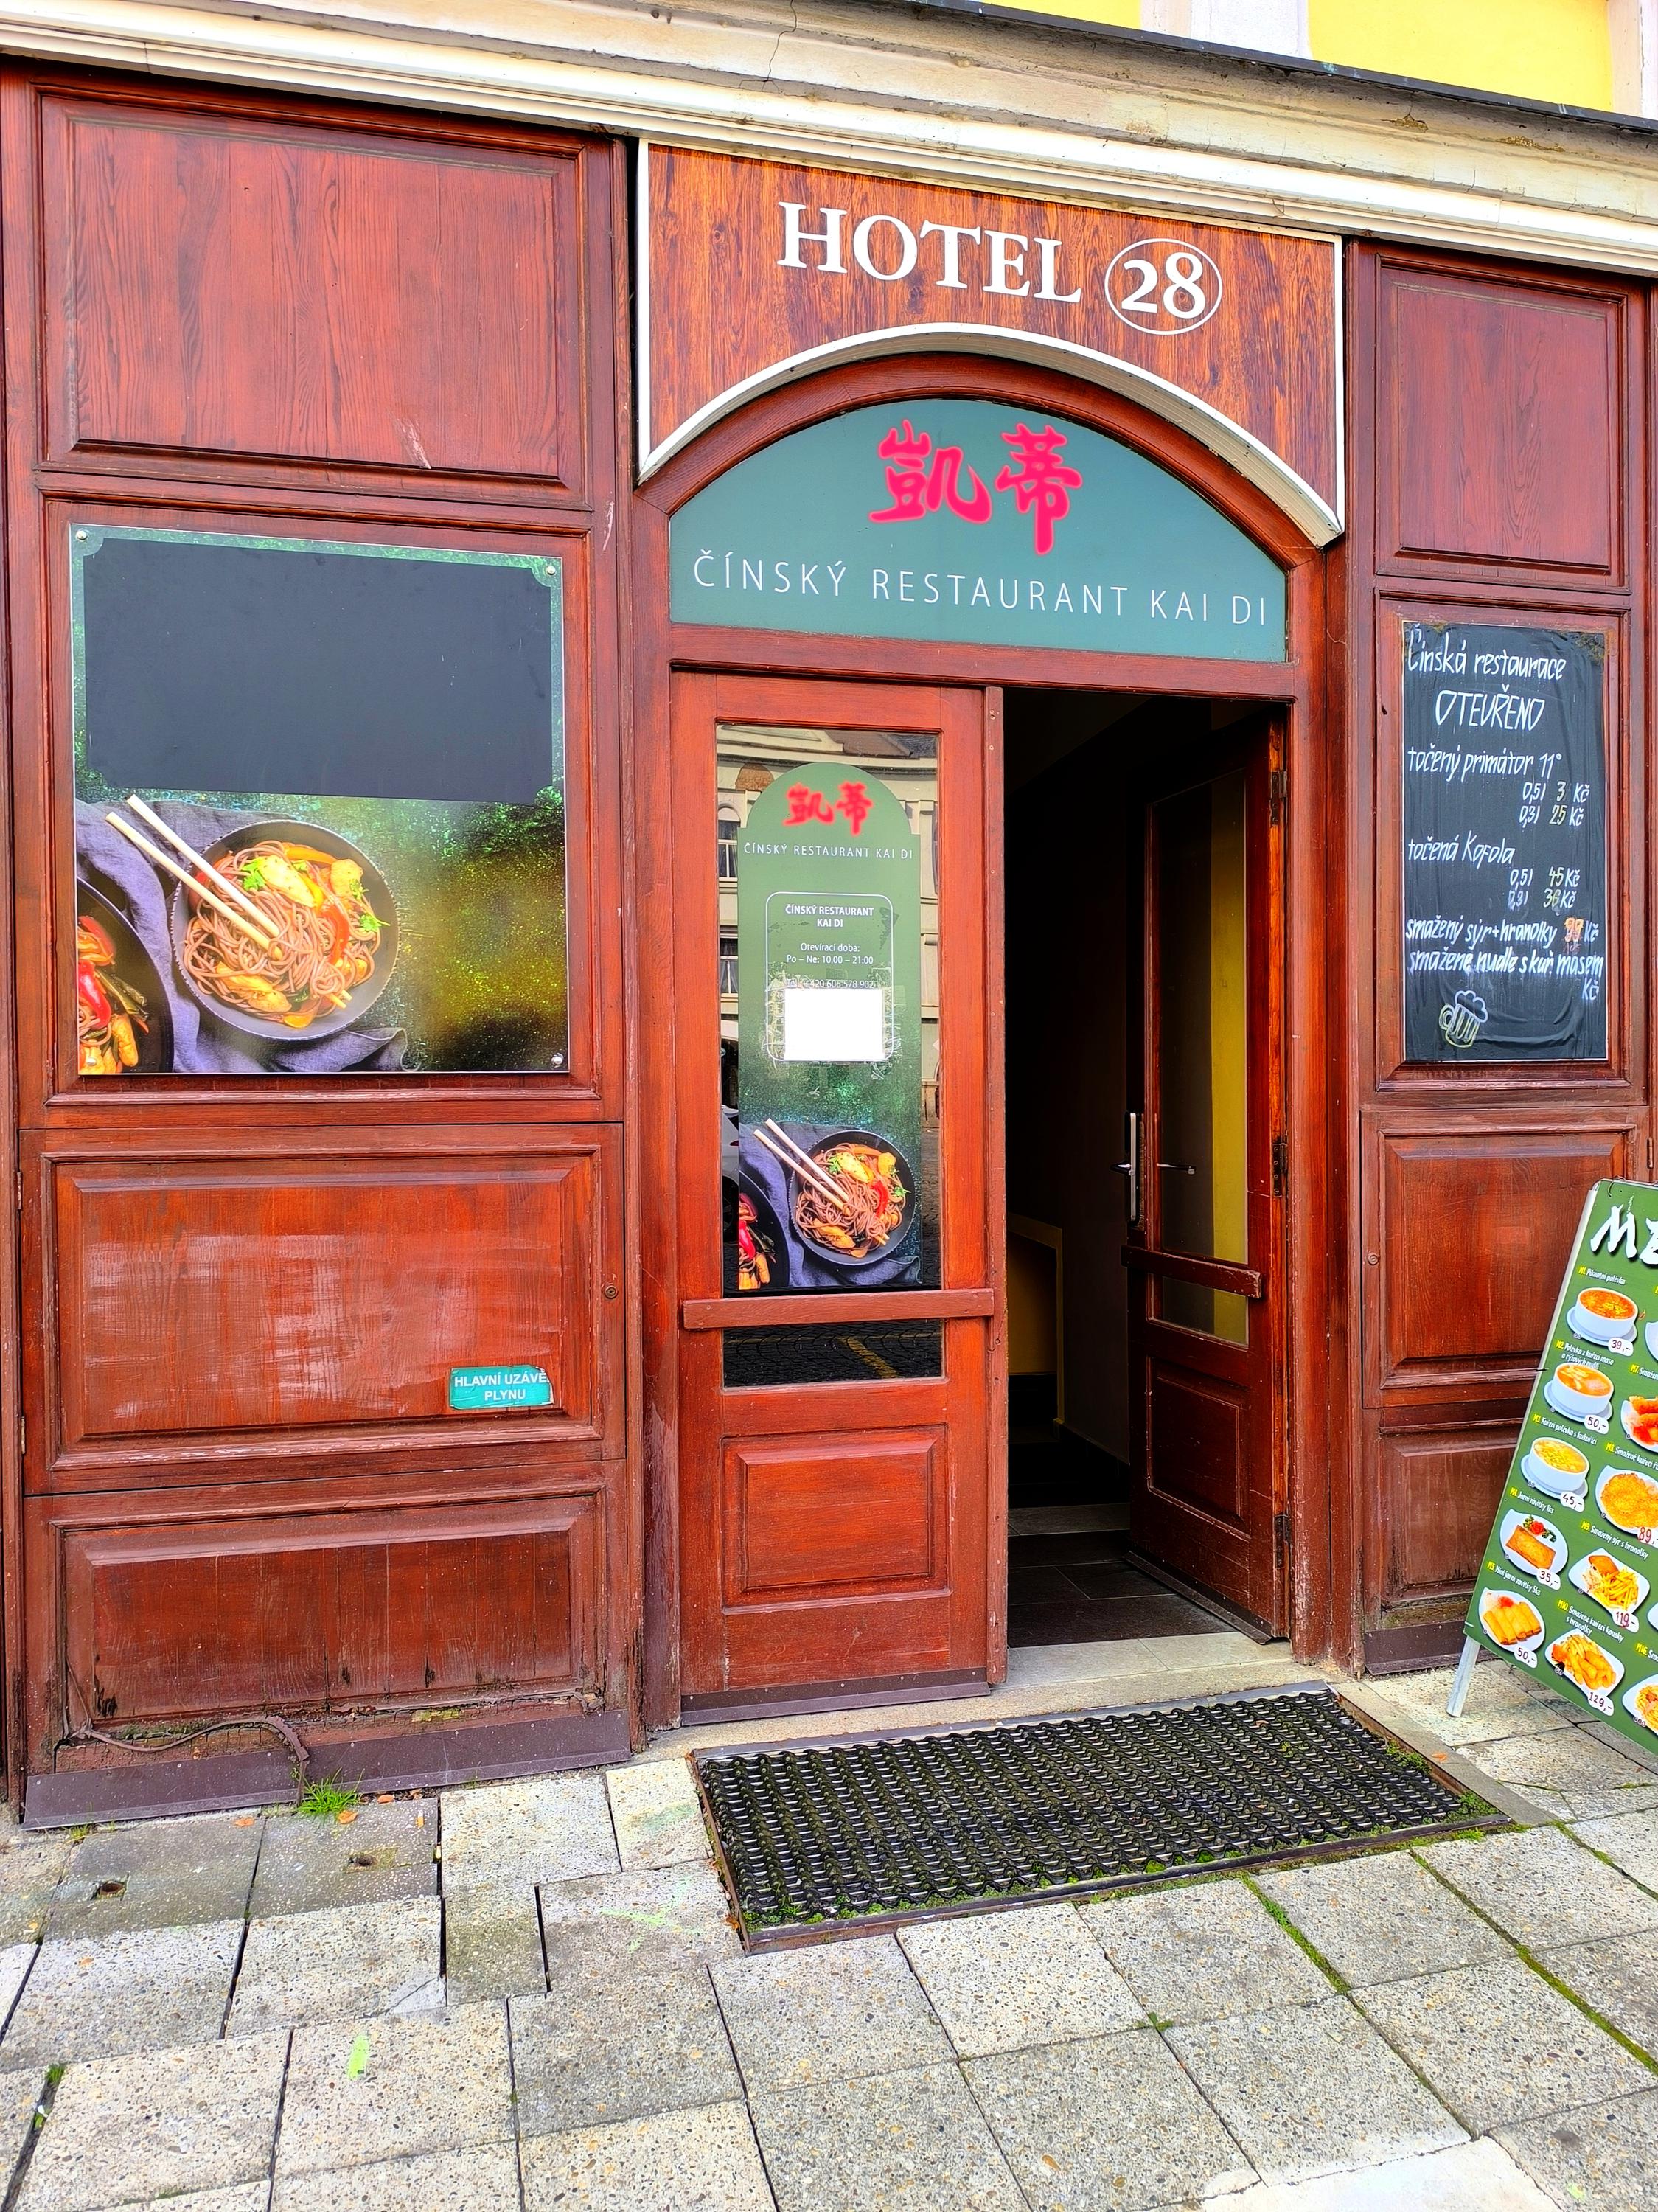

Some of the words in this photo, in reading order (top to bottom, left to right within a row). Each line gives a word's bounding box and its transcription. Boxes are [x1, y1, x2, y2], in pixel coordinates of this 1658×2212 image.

[777, 201, 1082, 303] HOTEL
[1121, 252, 1206, 319] 28
[868, 418, 1084, 557] 凱蒂
[694, 549, 847, 595] ČÍNSKÝ
[873, 568, 1128, 616] RESTAURANT
[1151, 590, 1208, 622] KAI
[1233, 595, 1266, 626] DI
[1474, 649, 1567, 680] restaurace
[1435, 683, 1545, 731] OTEVŘENO
[1407, 742, 1461, 782] točený
[1463, 747, 1534, 782] primátor
[1572, 782, 1590, 803] Kč
[781, 780, 874, 836] 凱蒂
[1549, 804, 1567, 825] 25
[1569, 806, 1584, 826] Kč
[744, 842, 788, 854] ČÍNSKÝ
[794, 845, 870, 858] RESTAURANT
[876, 849, 894, 858] KAI
[901, 849, 913, 859] DI
[1407, 834, 1460, 861] točená
[1462, 830, 1516, 869] Kofola
[1564, 868, 1581, 887] Kč
[785, 904, 817, 915] ČÍNSKÝ
[819, 906, 874, 916] RESTAURANT
[1559, 889, 1577, 908] Kč
[817, 919, 832, 927] KAI
[834, 919, 843, 928] DI
[1405, 915, 1464, 945] smažený
[1584, 920, 1599, 942] Kč
[837, 943, 860, 952] doba:
[787, 955, 796, 963] Po
[807, 955, 820, 964] Ne:
[852, 956, 874, 964] 21:00
[1476, 946, 1519, 973] nudle
[1519, 956, 1528, 973] s
[1556, 953, 1604, 978] masem
[1581, 977, 1600, 1001] Kč
[454, 1372, 501, 1388] HLAVNÍ
[504, 1369, 550, 1385] UZÁVĚ
[484, 1389, 526, 1401] PLYNU
